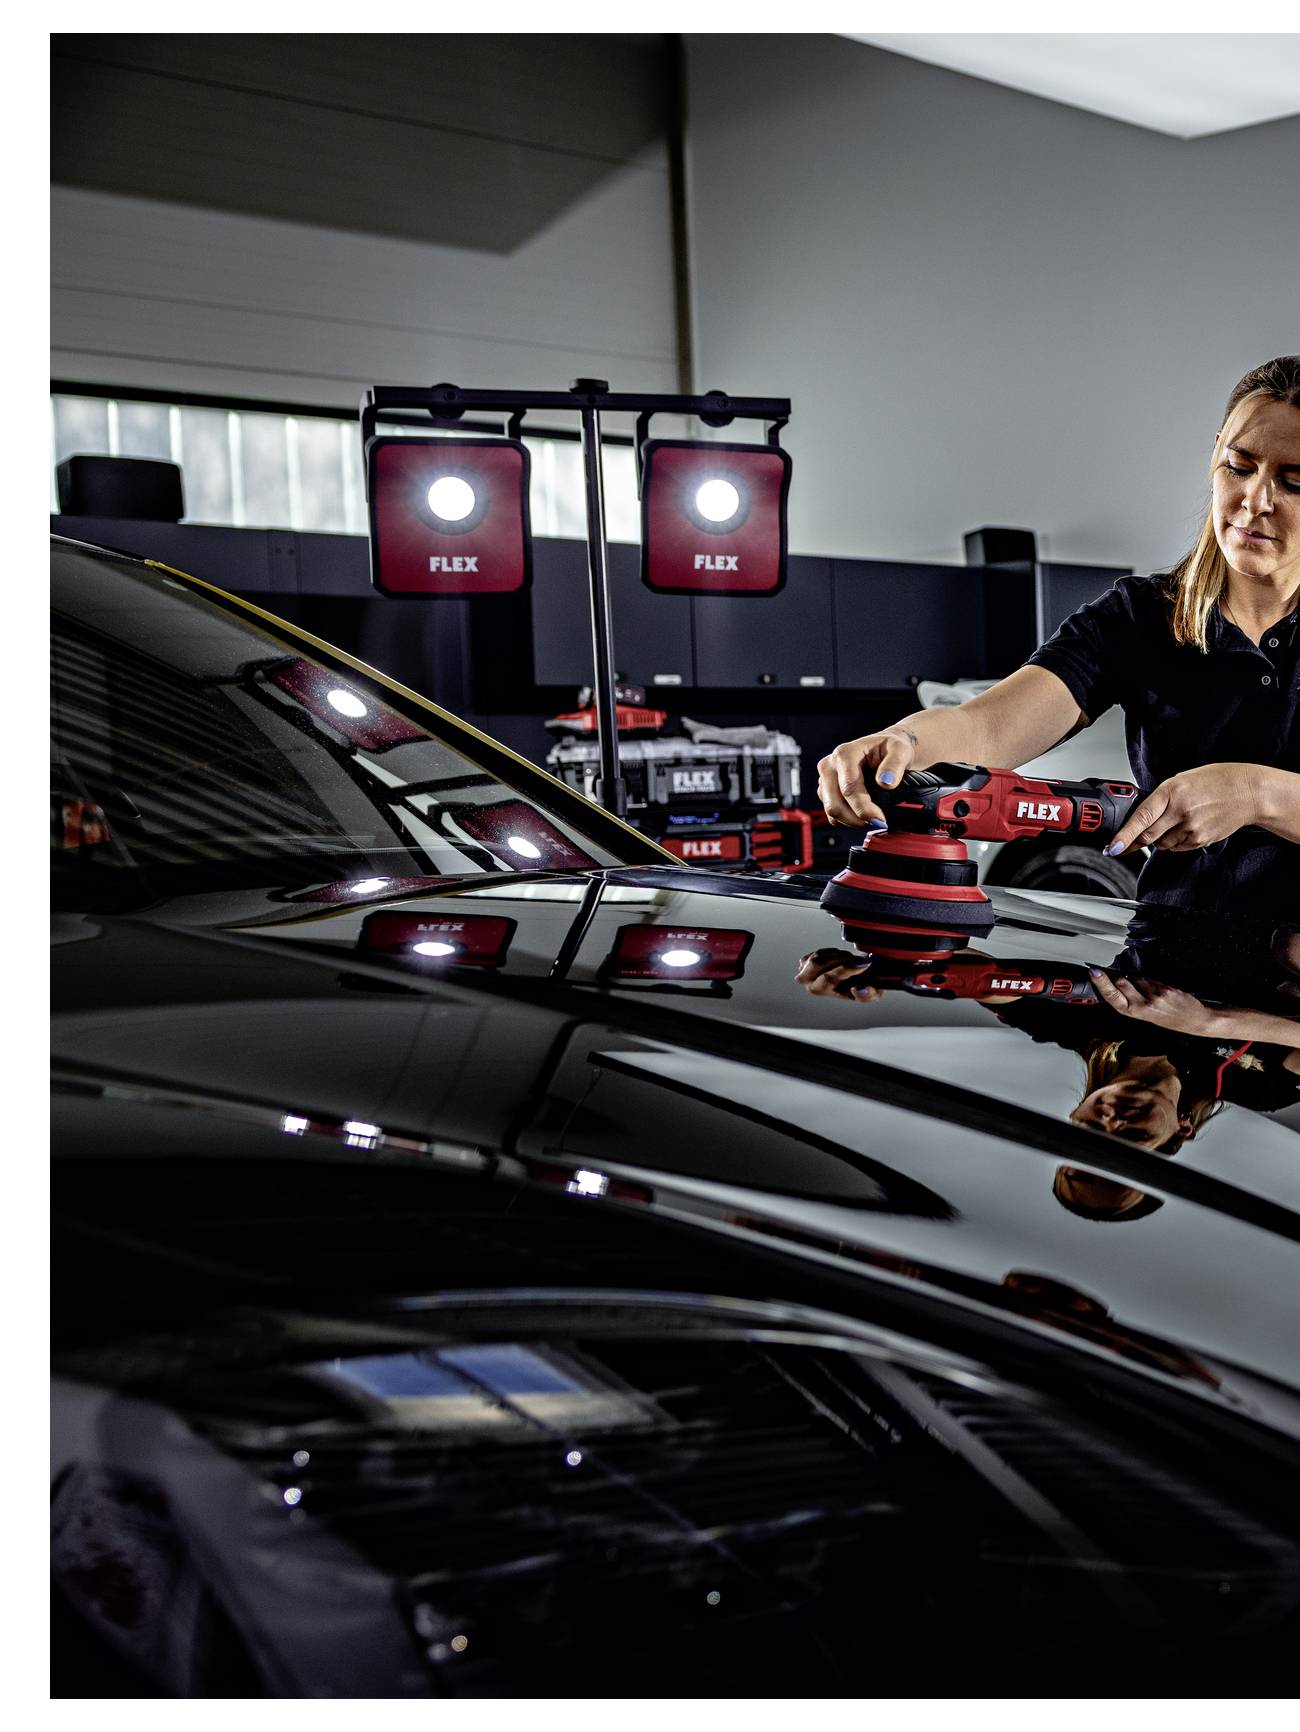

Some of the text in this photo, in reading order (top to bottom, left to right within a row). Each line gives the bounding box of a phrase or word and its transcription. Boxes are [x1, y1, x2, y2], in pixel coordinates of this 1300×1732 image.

[429, 556, 479, 573] FLEX
[694, 554, 739, 571] FLEX
[673, 771, 715, 785] FLEX
[1017, 801, 1061, 822] FLEX
[682, 842, 722, 855] FLEX
